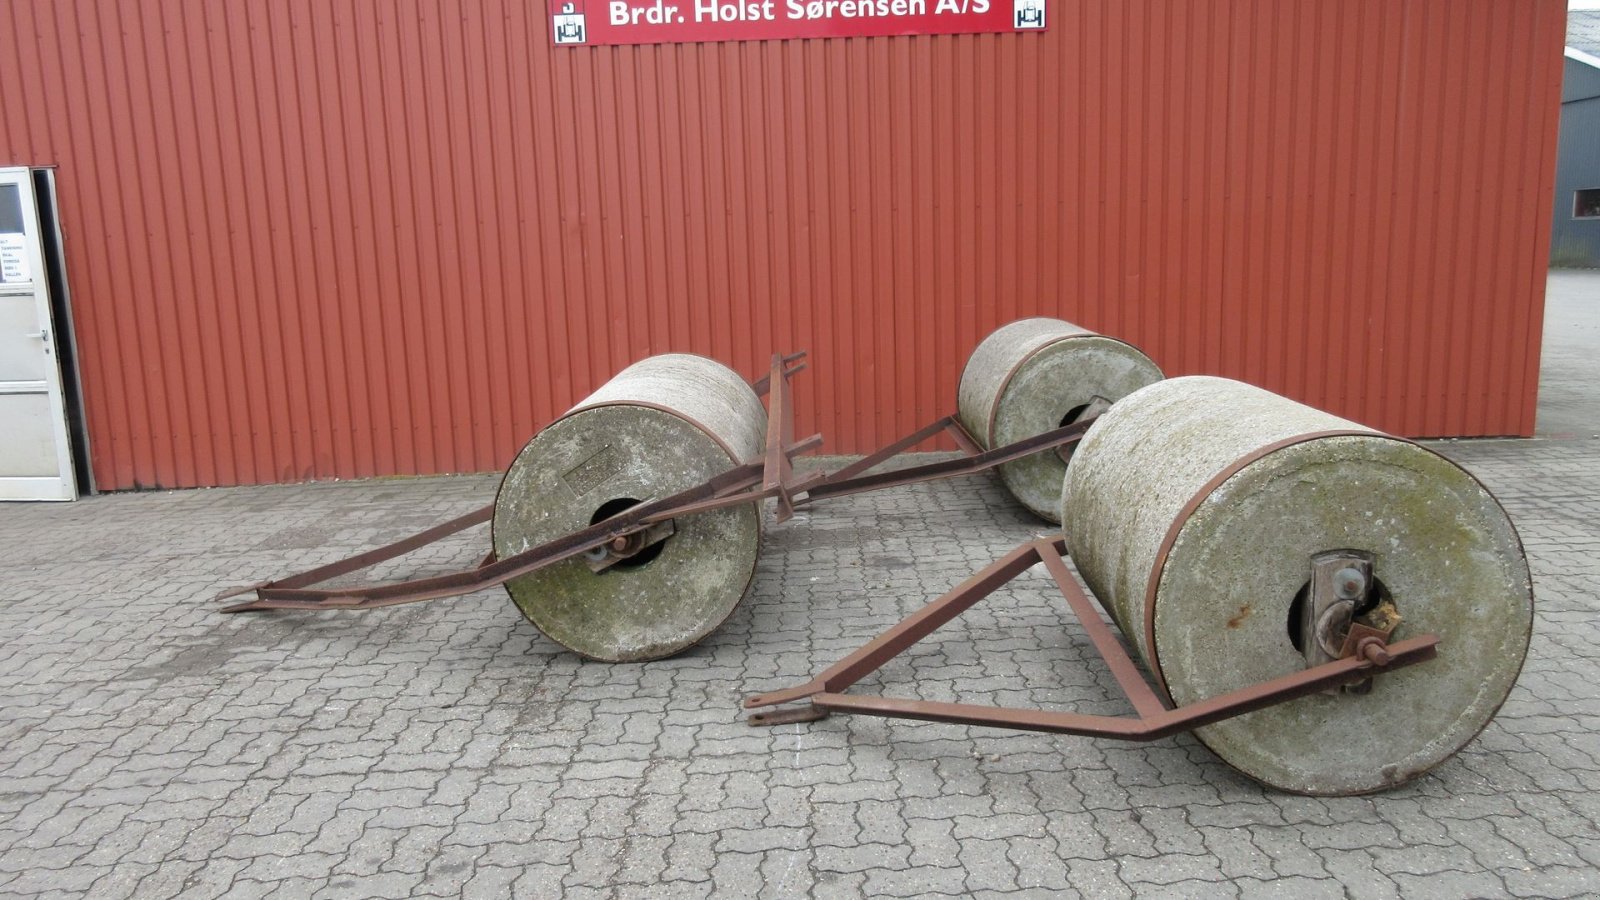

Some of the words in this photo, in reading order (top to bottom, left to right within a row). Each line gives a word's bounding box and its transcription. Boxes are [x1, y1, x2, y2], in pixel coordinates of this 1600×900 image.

[609, 0, 685, 26] Brdr.
[694, 0, 776, 23] Holst
[786, 0, 926, 20] Sørensen
[934, 0, 990, 15] A/S
